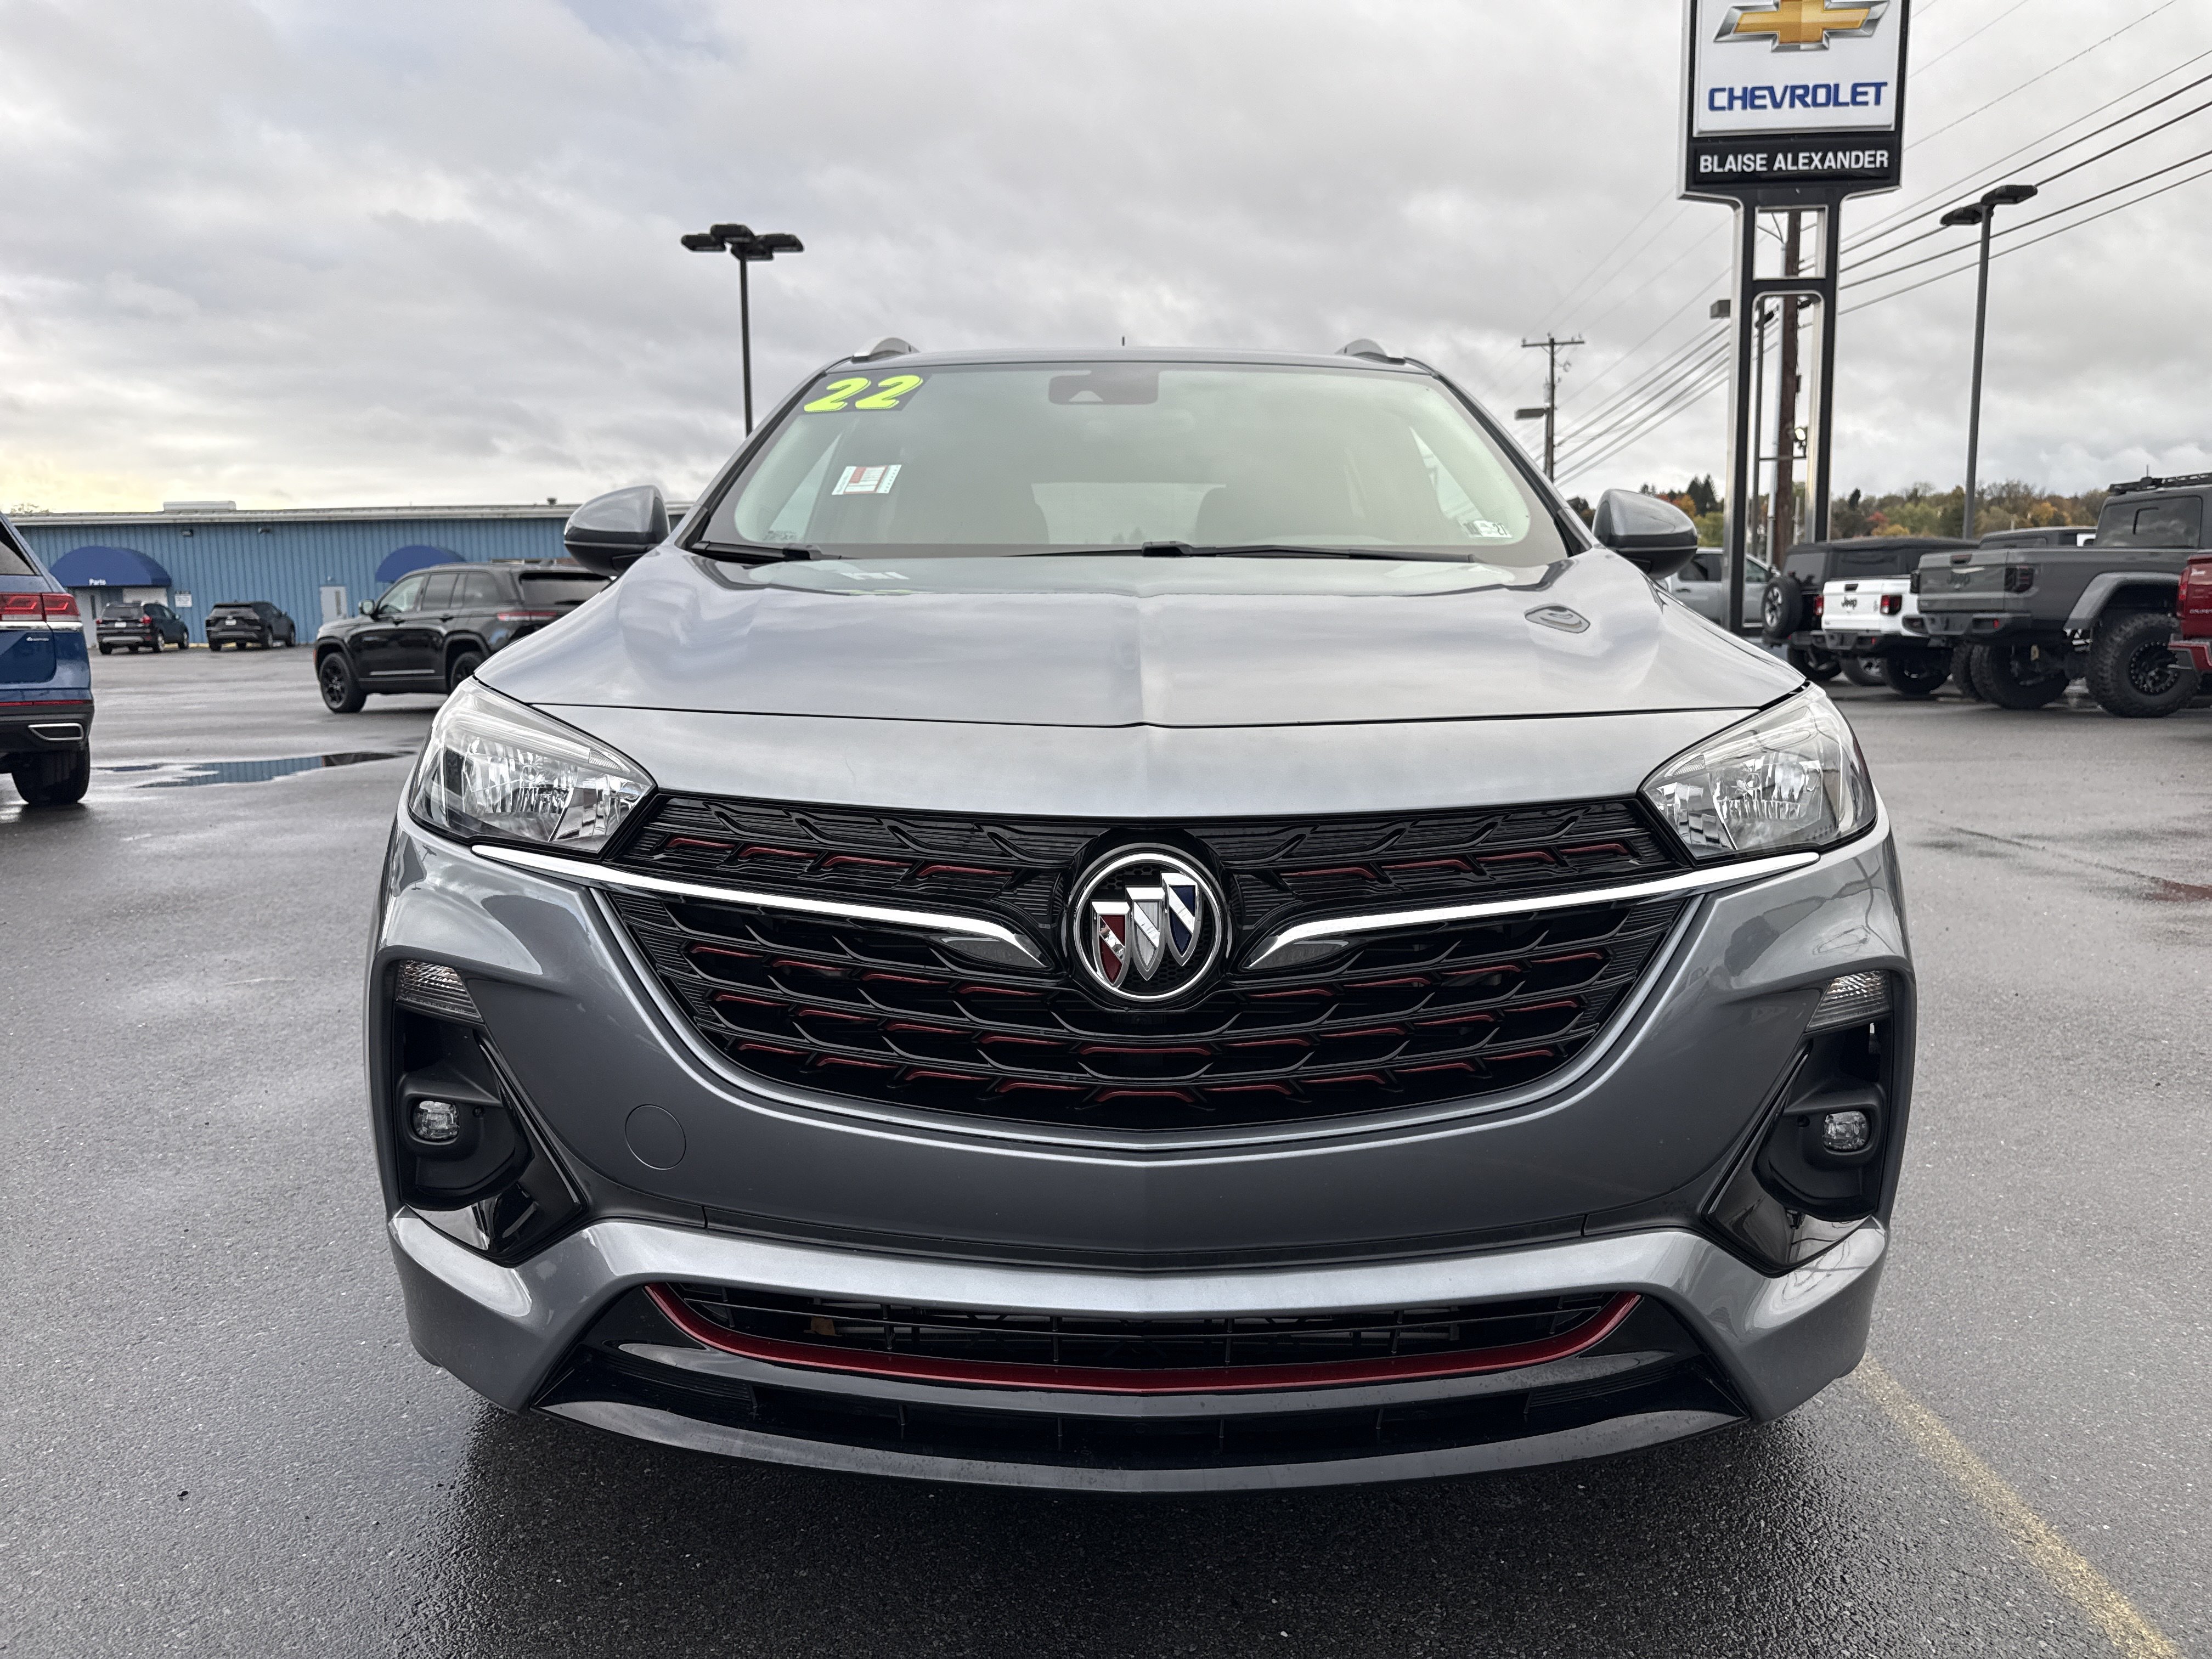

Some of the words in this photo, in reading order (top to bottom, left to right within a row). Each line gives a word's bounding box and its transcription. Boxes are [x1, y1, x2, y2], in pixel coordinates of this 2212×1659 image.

[1708, 82, 1888, 111] CHEVROLET
[1700, 154, 1768, 173] BLAISE
[1773, 150, 1889, 171] ALEXANDER
[804, 375, 924, 413] 22
